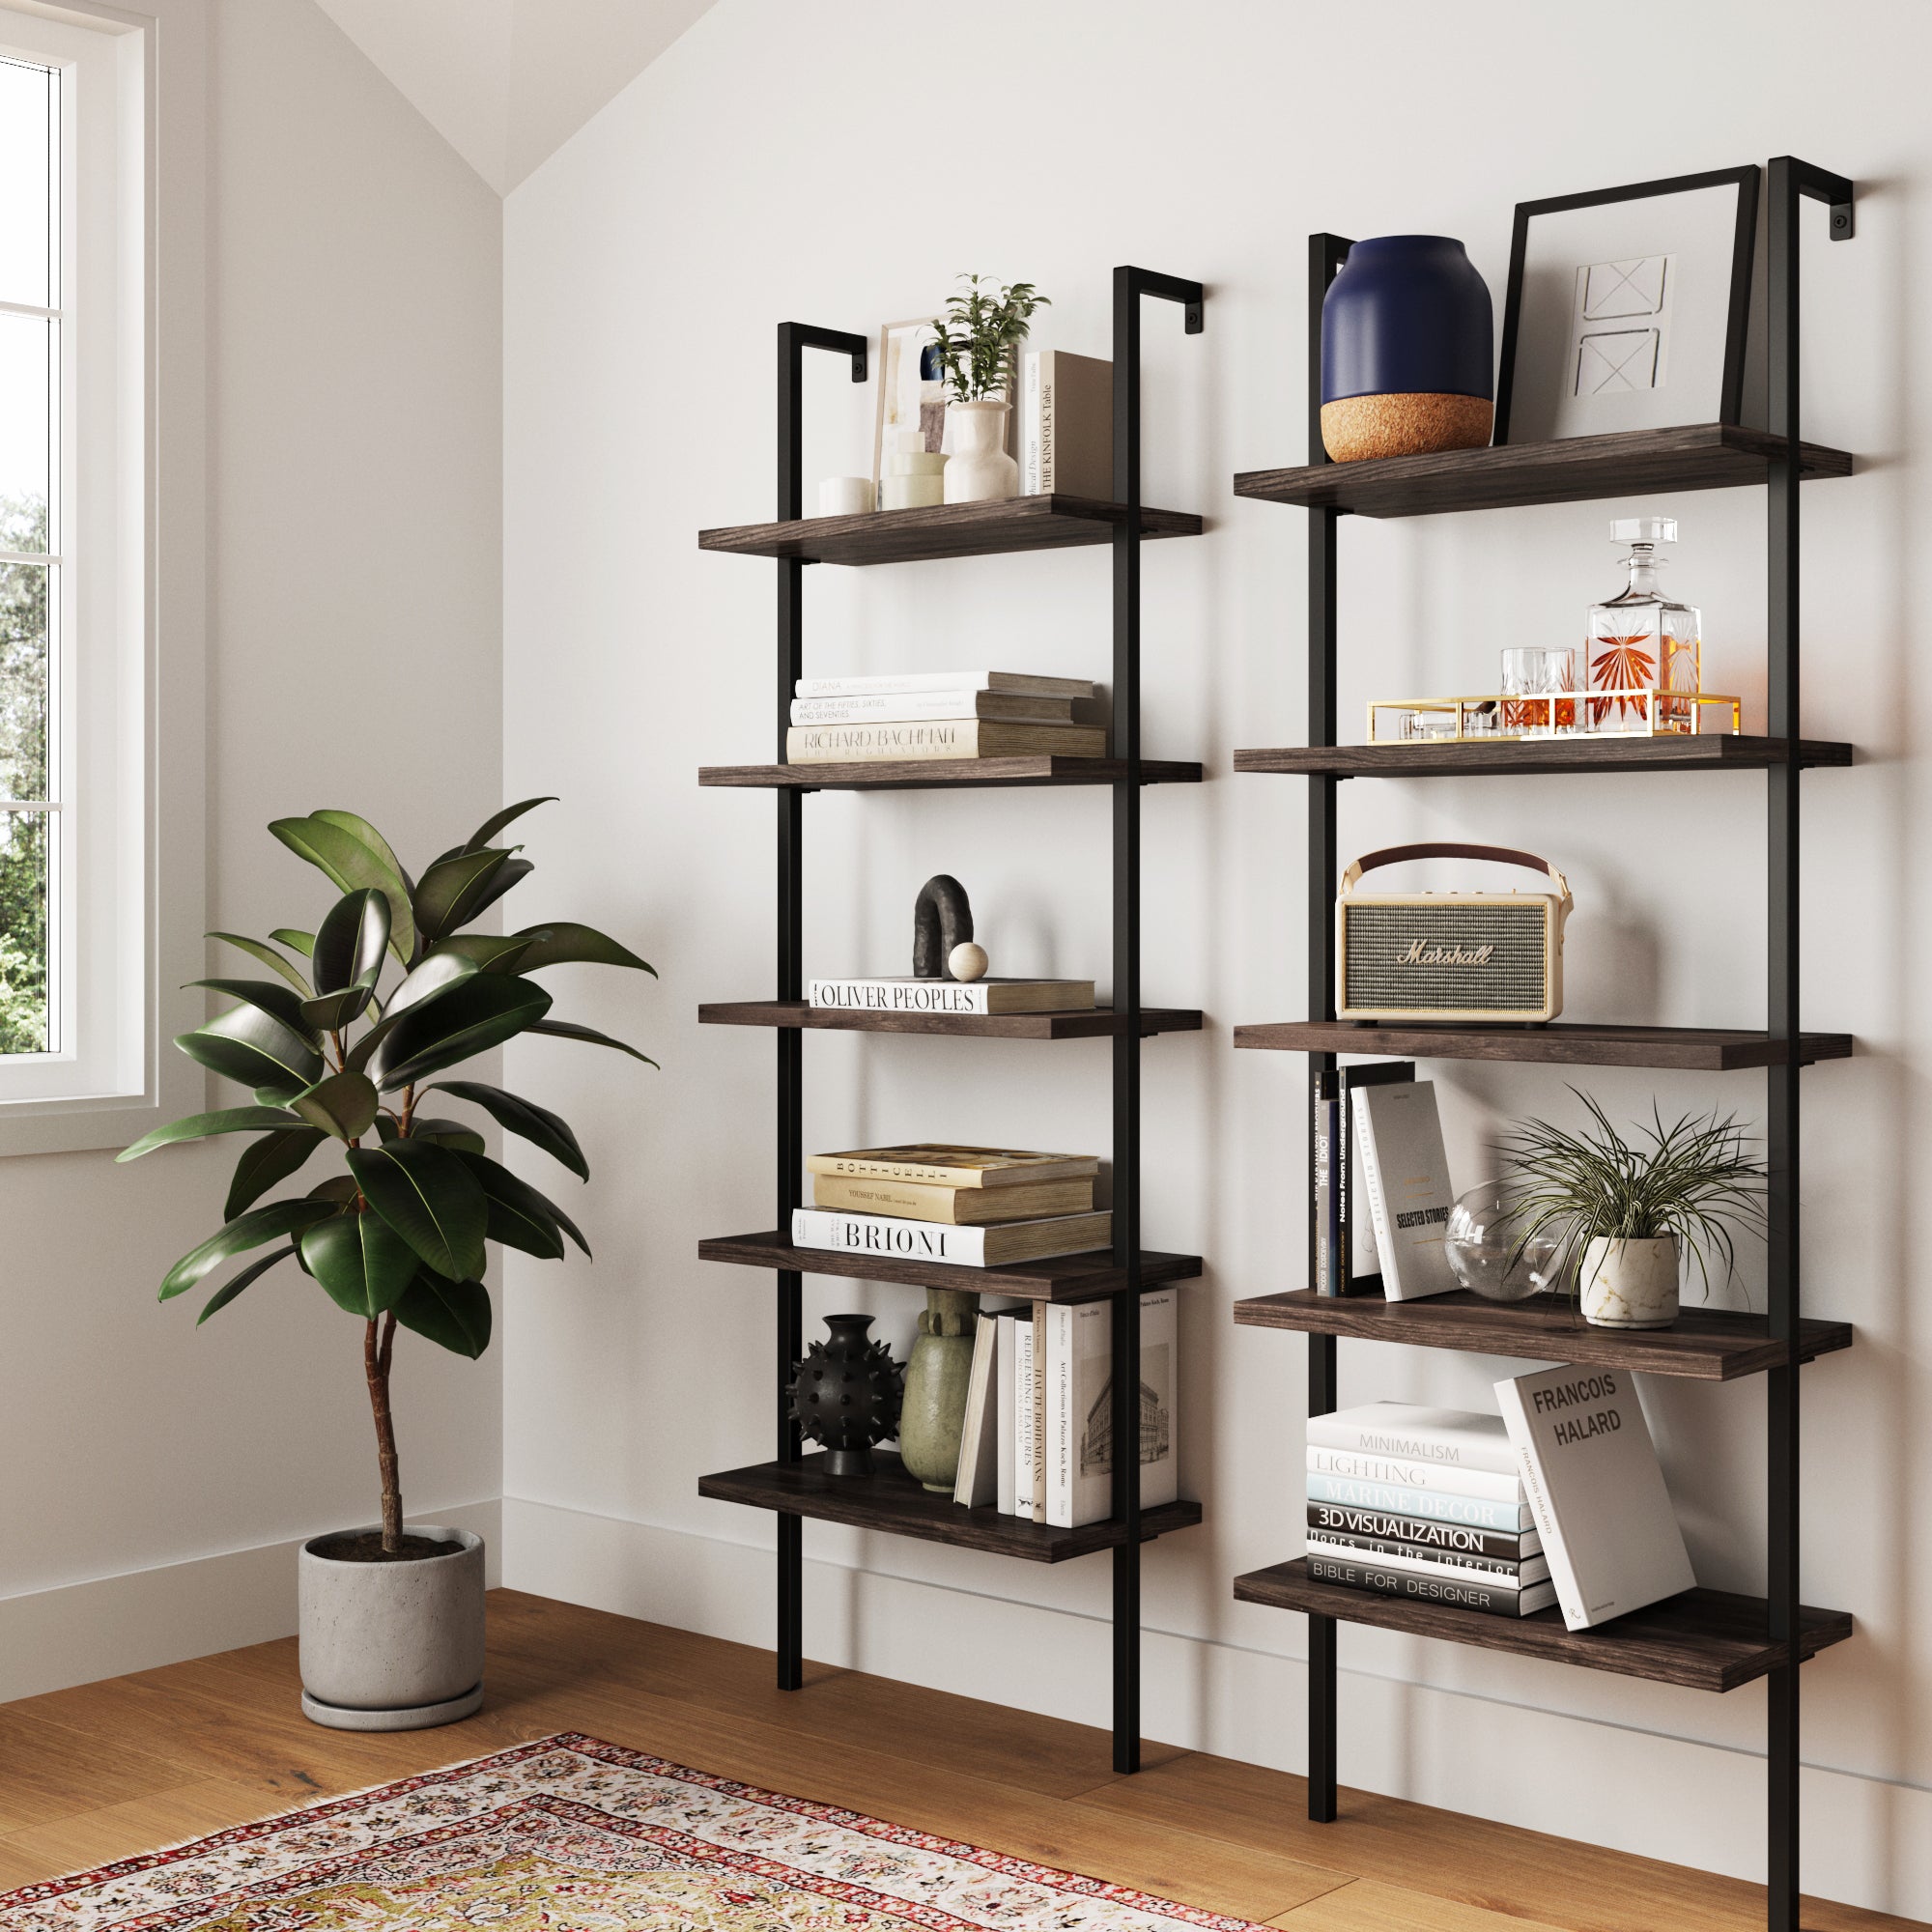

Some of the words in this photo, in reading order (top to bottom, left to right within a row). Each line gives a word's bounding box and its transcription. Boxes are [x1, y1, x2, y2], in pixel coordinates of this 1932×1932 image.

[1042, 384, 1052, 412] Table
[1042, 412, 1052, 464] KINFOLK
[1029, 440, 1037, 469] Design
[1042, 468, 1052, 491] THE
[811, 681, 842, 692] DIANA
[799, 711, 814, 720] AND
[815, 710, 850, 719] SEVENTIES
[804, 730, 871, 749] RICHARD
[877, 727, 955, 747] BACHMAN
[1397, 939, 1493, 964] Marshall
[822, 984, 889, 1009] OLIVER
[894, 987, 974, 1011] PEOPLES
[1320, 1135, 1328, 1163] IDIOT
[837, 1162, 948, 1179] BOTTICELLI
[1320, 1169, 1328, 1187] THE
[849, 1189, 874, 1200] YOUSSEF
[875, 1192, 894, 1203] NABIL
[1396, 1209, 1426, 1230] SELECTED
[1425, 1206, 1449, 1226] STORIES
[844, 1222, 948, 1257] BRIONI
[1532, 1374, 1616, 1413] FRANCOIS
[1553, 1409, 1621, 1446] HALARD
[1359, 1434, 1460, 1461] MINIMALISM
[1317, 1453, 1425, 1486] LIGHTING
[1325, 1481, 1412, 1513] MARINE
[1419, 1499, 1498, 1526] DECOR
[1521, 1446, 1540, 1493] FRANCOIS
[1536, 1495, 1552, 1534] HALARD
[1319, 1508, 1345, 1528] 3D
[1347, 1512, 1484, 1552] VISUALIZATION
[1310, 1530, 1355, 1548] Doors
[1369, 1540, 1383, 1555] in
[1398, 1545, 1424, 1561] the
[1437, 1552, 1515, 1577] interior
[1313, 1563, 1356, 1582] BIBLE
[1365, 1572, 1398, 1590] FOR
[1406, 1579, 1492, 1607] DESIGNER
